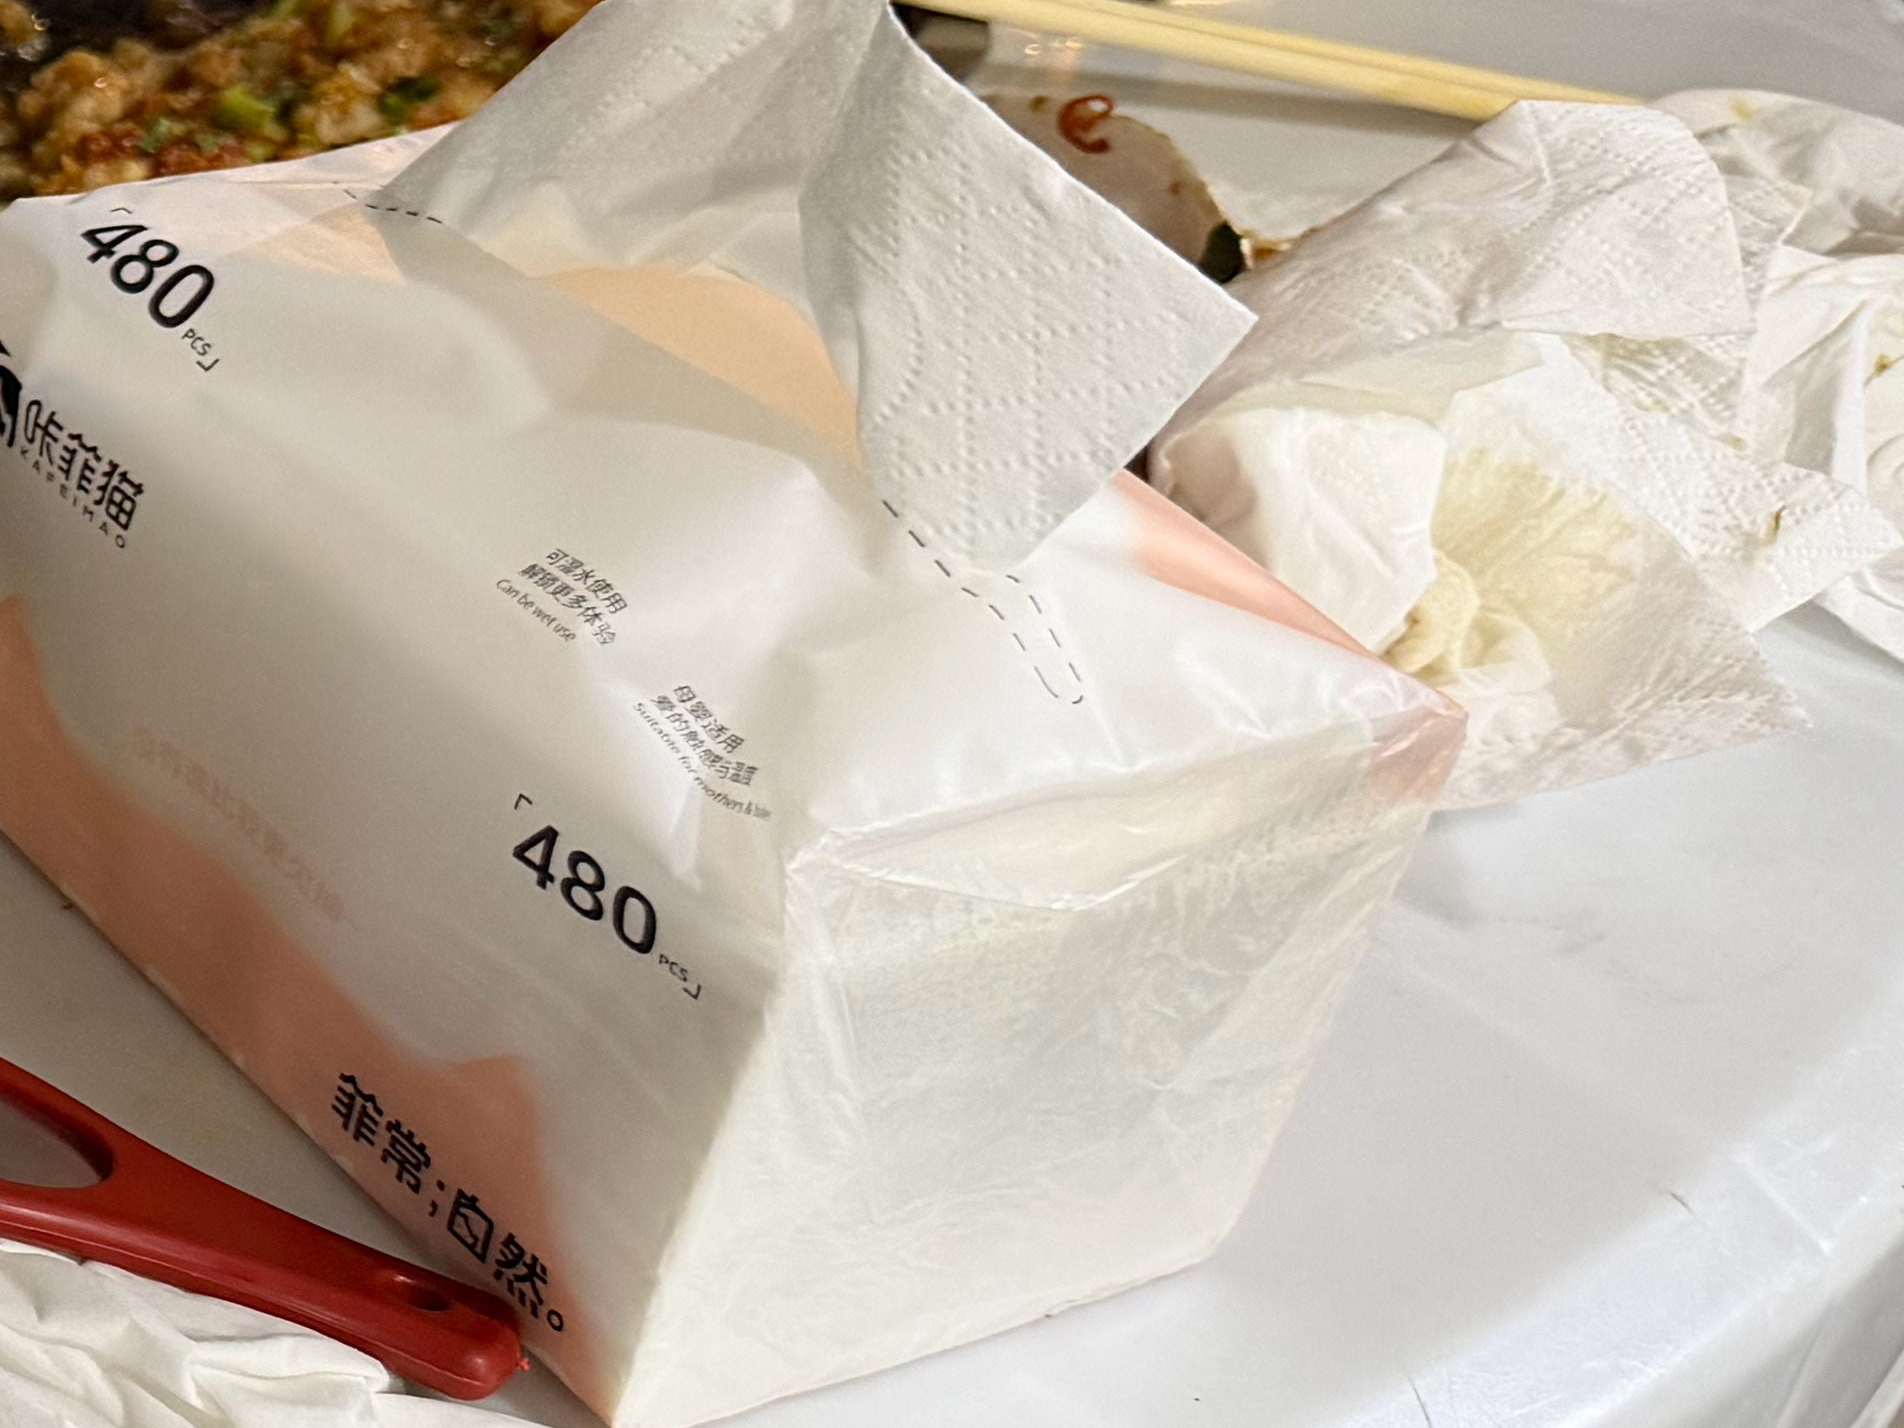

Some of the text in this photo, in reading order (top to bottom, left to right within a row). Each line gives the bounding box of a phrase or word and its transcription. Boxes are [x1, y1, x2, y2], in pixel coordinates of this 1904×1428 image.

[80, 224, 215, 329] 480
[181, 328, 213, 357] PCS
[24, 399, 145, 531] 咔菲猫
[496, 578, 577, 642] Can be wet use
[633, 702, 682, 755] Suitable
[678, 756, 698, 775] for
[512, 824, 658, 955] 480
[658, 953, 690, 983] PCS
